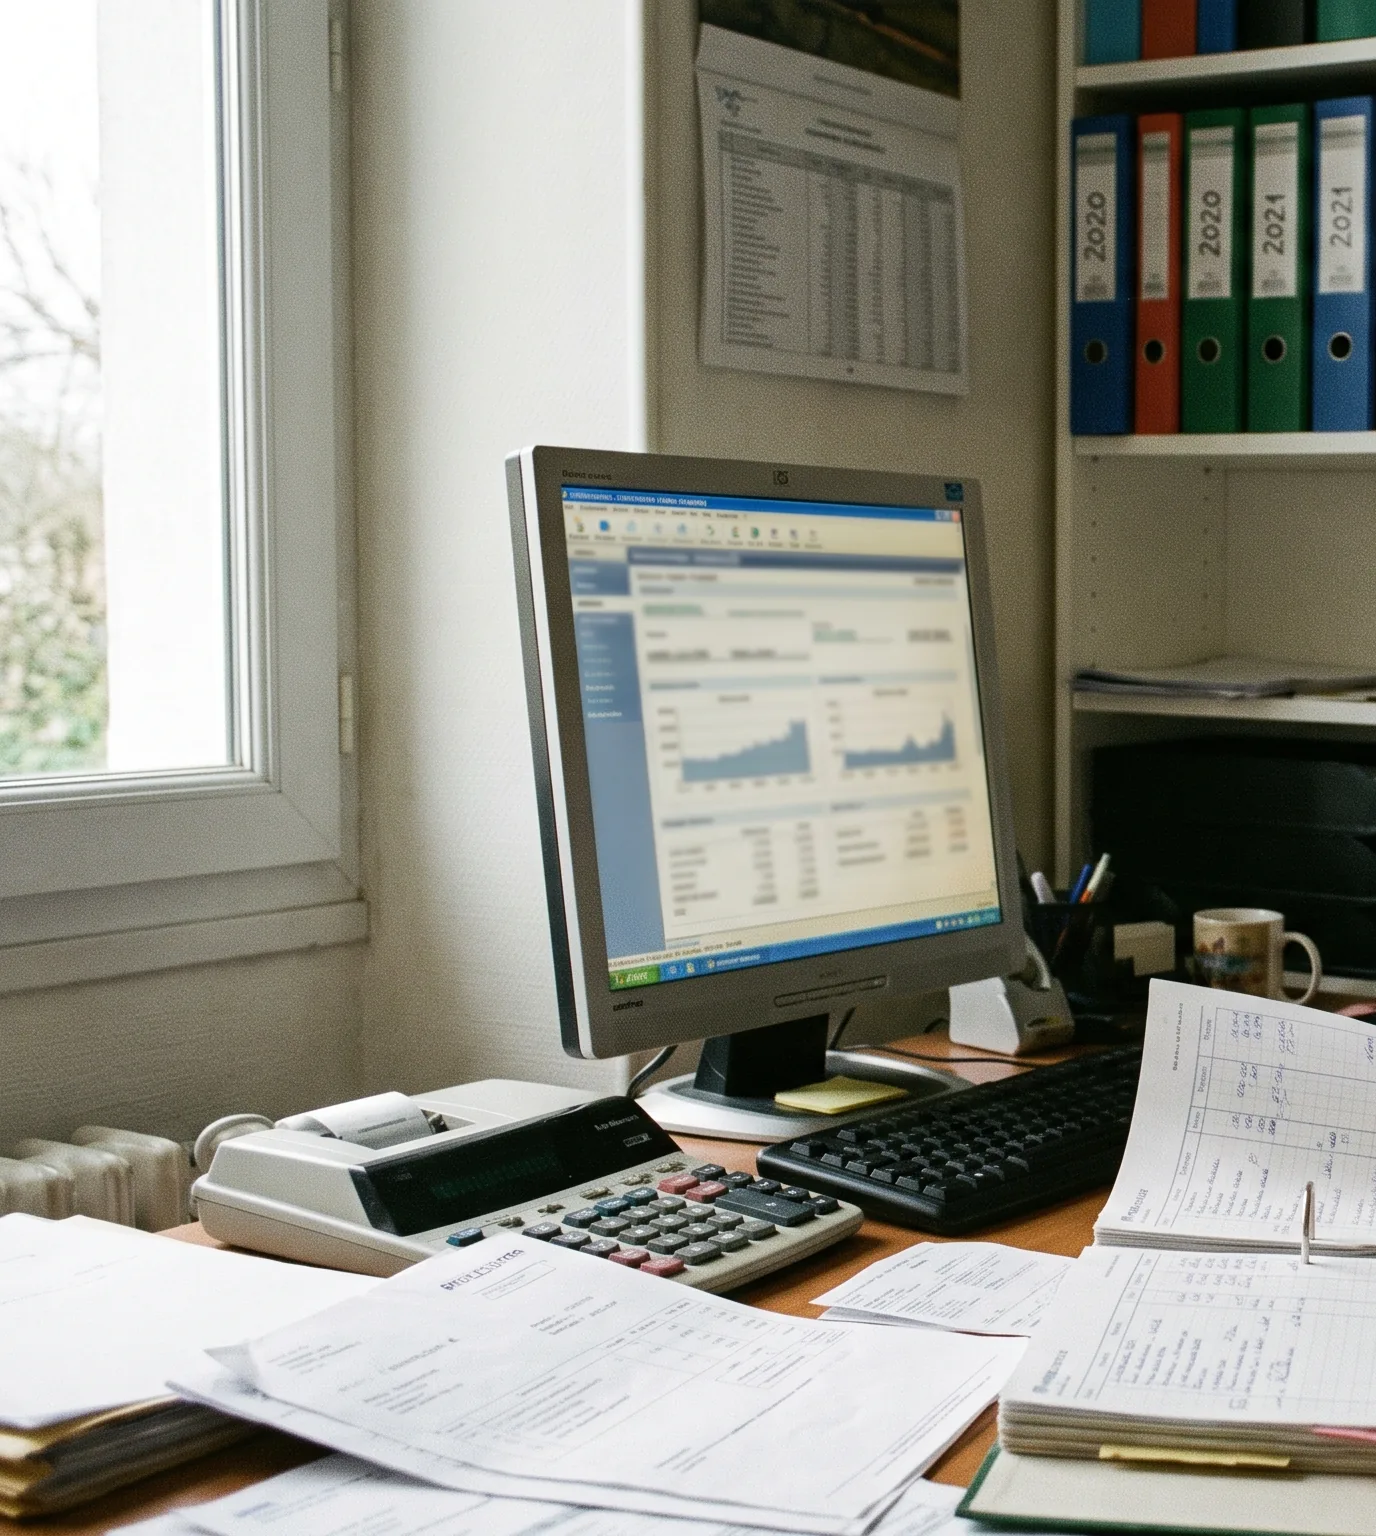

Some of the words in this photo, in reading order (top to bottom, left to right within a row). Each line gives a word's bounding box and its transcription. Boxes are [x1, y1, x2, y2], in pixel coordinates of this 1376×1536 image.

[1084, 192, 1106, 261] 2020
[1200, 190, 1221, 259] 2020
[1262, 193, 1285, 257] 2021
[1330, 187, 1352, 247] 2021
